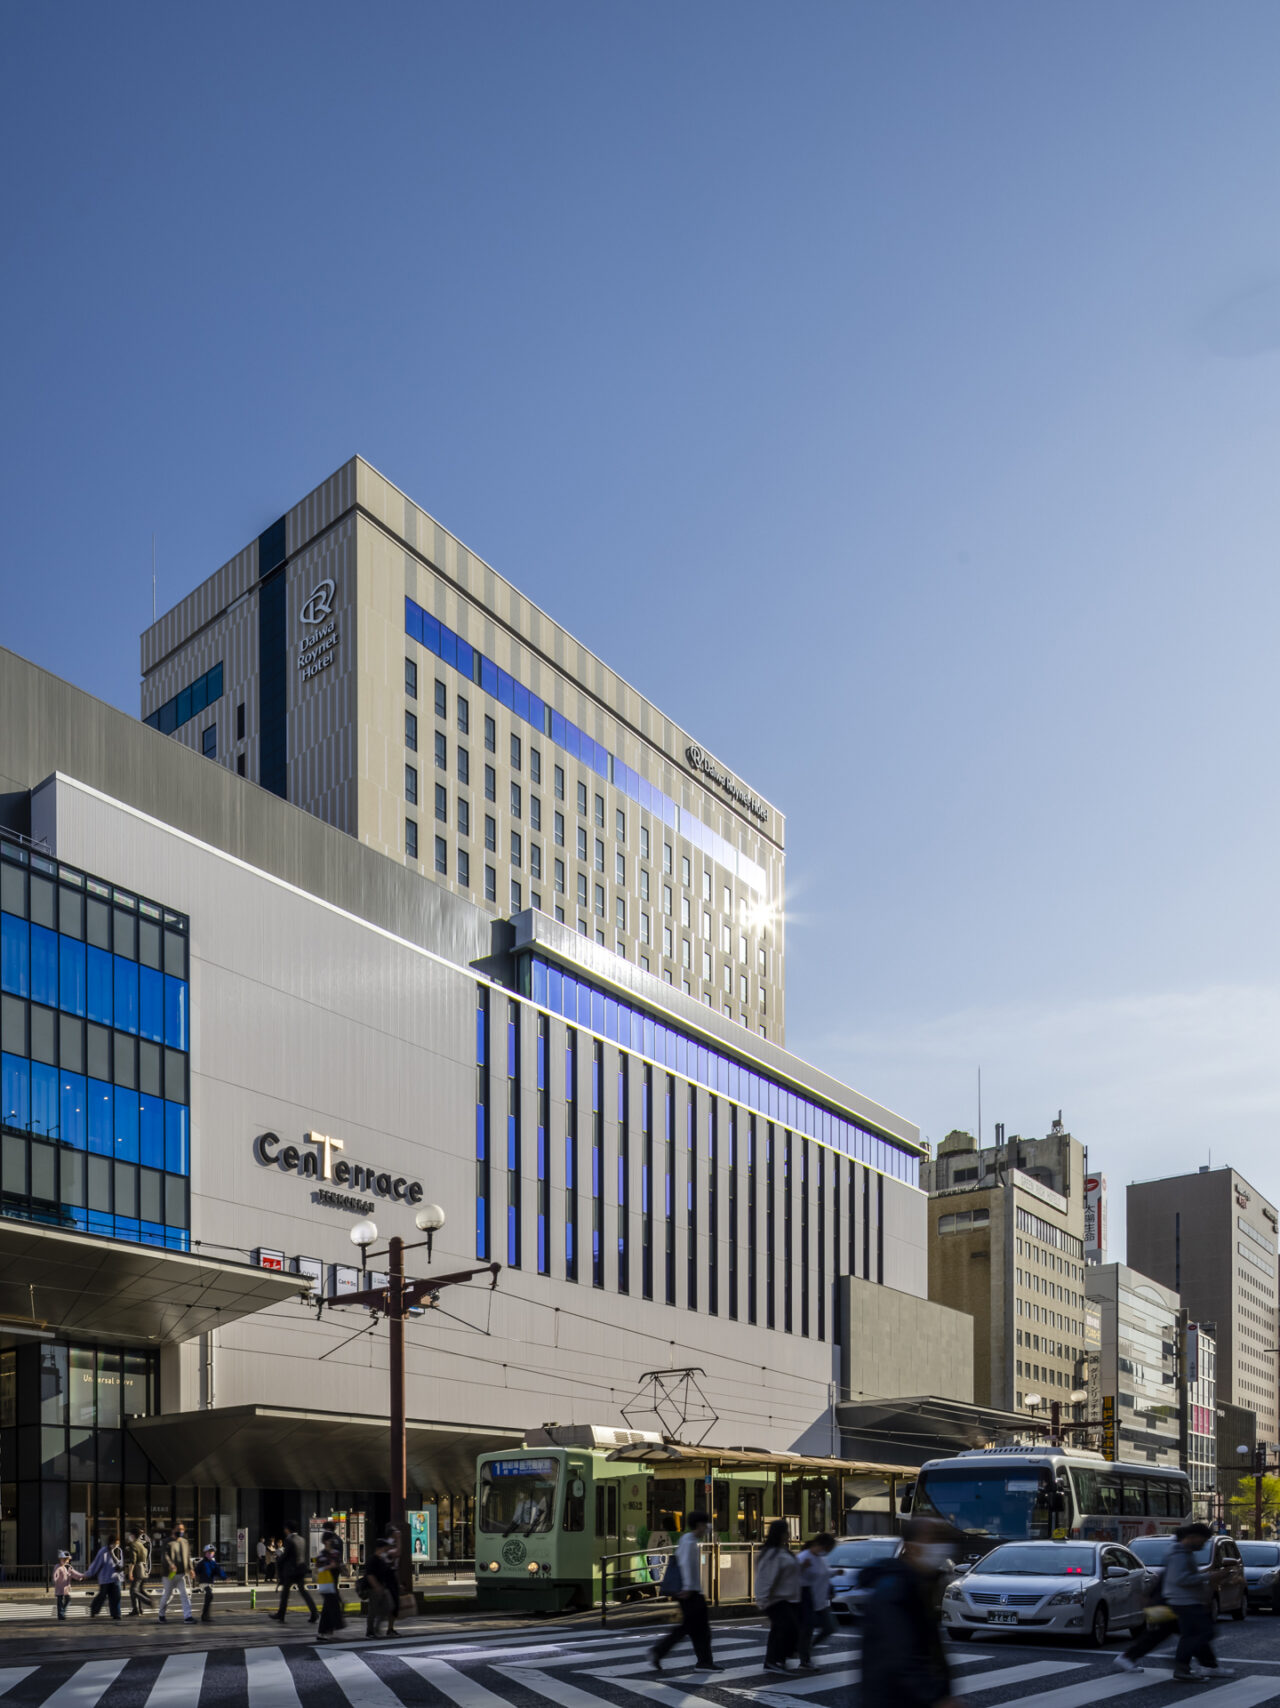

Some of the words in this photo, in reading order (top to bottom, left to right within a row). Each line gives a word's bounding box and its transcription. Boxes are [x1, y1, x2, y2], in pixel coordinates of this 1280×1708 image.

[297, 632, 339, 670] Roynet
[300, 621, 335, 652] Daiwa
[302, 651, 334, 682] Hotel
[258, 1131, 424, 1203] CenTerrace
[83, 1374, 114, 1385] Unersal
